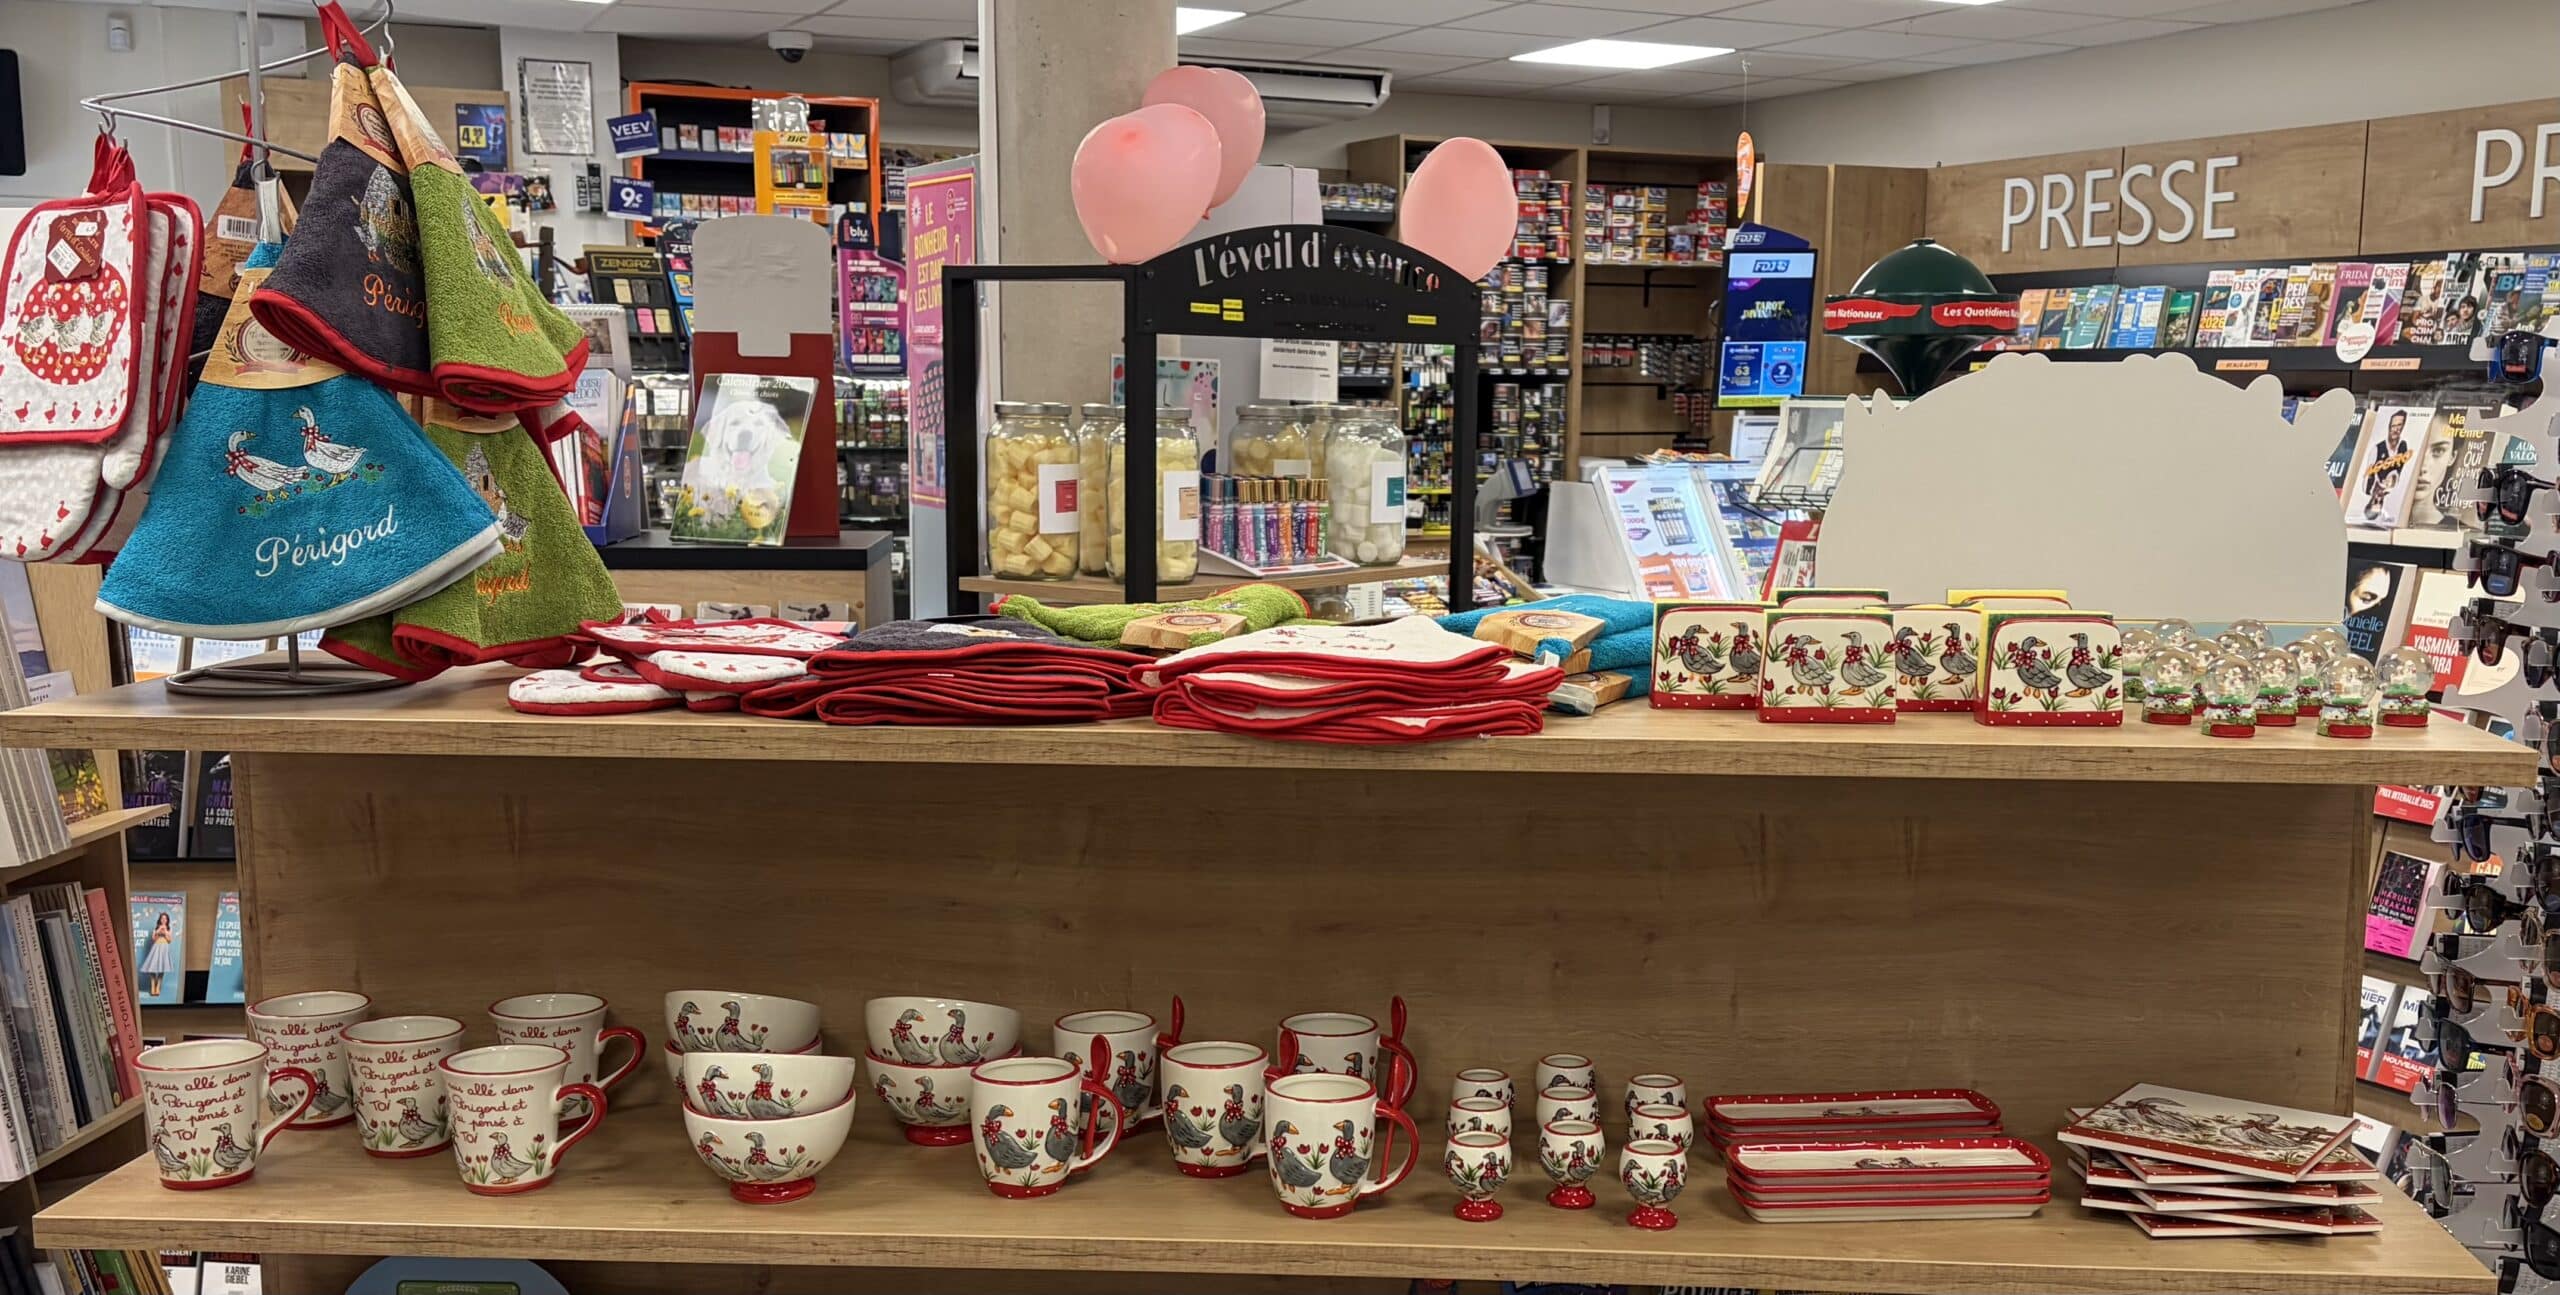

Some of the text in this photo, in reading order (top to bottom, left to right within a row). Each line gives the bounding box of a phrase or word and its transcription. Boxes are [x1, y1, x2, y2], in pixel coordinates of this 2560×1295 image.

[611, 120, 651, 138] VEEV
[2001, 155, 2240, 253] PRESSE
[925, 202, 934, 225] LE
[914, 226, 948, 260] BONHEUR
[1194, 229, 1294, 287] L'éveil
[2340, 270, 2369, 280] FRIDA
[915, 287, 928, 312] LES
[1943, 307, 1962, 318] Les
[1964, 307, 2011, 319] Quotidiens
[255, 504, 398, 577] Périgord
[2414, 633, 2460, 658] YASMINA
[2421, 798, 2436, 810] 2025
[204, 815, 214, 825] DU
[205, 808, 214, 817] LA
[2373, 895, 2417, 916] MURAKAMI
[280, 1023, 311, 1037] allé
[314, 1021, 344, 1034] dans
[520, 1025, 549, 1039] allé
[552, 1026, 583, 1039] dans
[324, 1035, 340, 1048] et
[283, 1053, 322, 1069] pensé
[377, 1049, 408, 1065] allé
[412, 1047, 442, 1061] dans
[422, 1062, 437, 1074] et
[2382, 1054, 2433, 1076] NOUVEAUTÉ
[185, 1075, 217, 1091] allé
[222, 1071, 252, 1086] dans
[380, 1079, 420, 1099] pensé
[232, 1086, 246, 1101] et
[467, 1083, 497, 1097] allé
[501, 1082, 534, 1095] dans
[370, 1099, 392, 1112] TOI
[512, 1100, 528, 1112] et
[159, 1104, 245, 1127] j'ai pensé à
[470, 1114, 509, 1131] pensé
[172, 1128, 198, 1141] TOI
[460, 1131, 478, 1145] TOI
[225, 1265, 252, 1276] KARINE
[225, 1275, 249, 1285] GIEBEL
